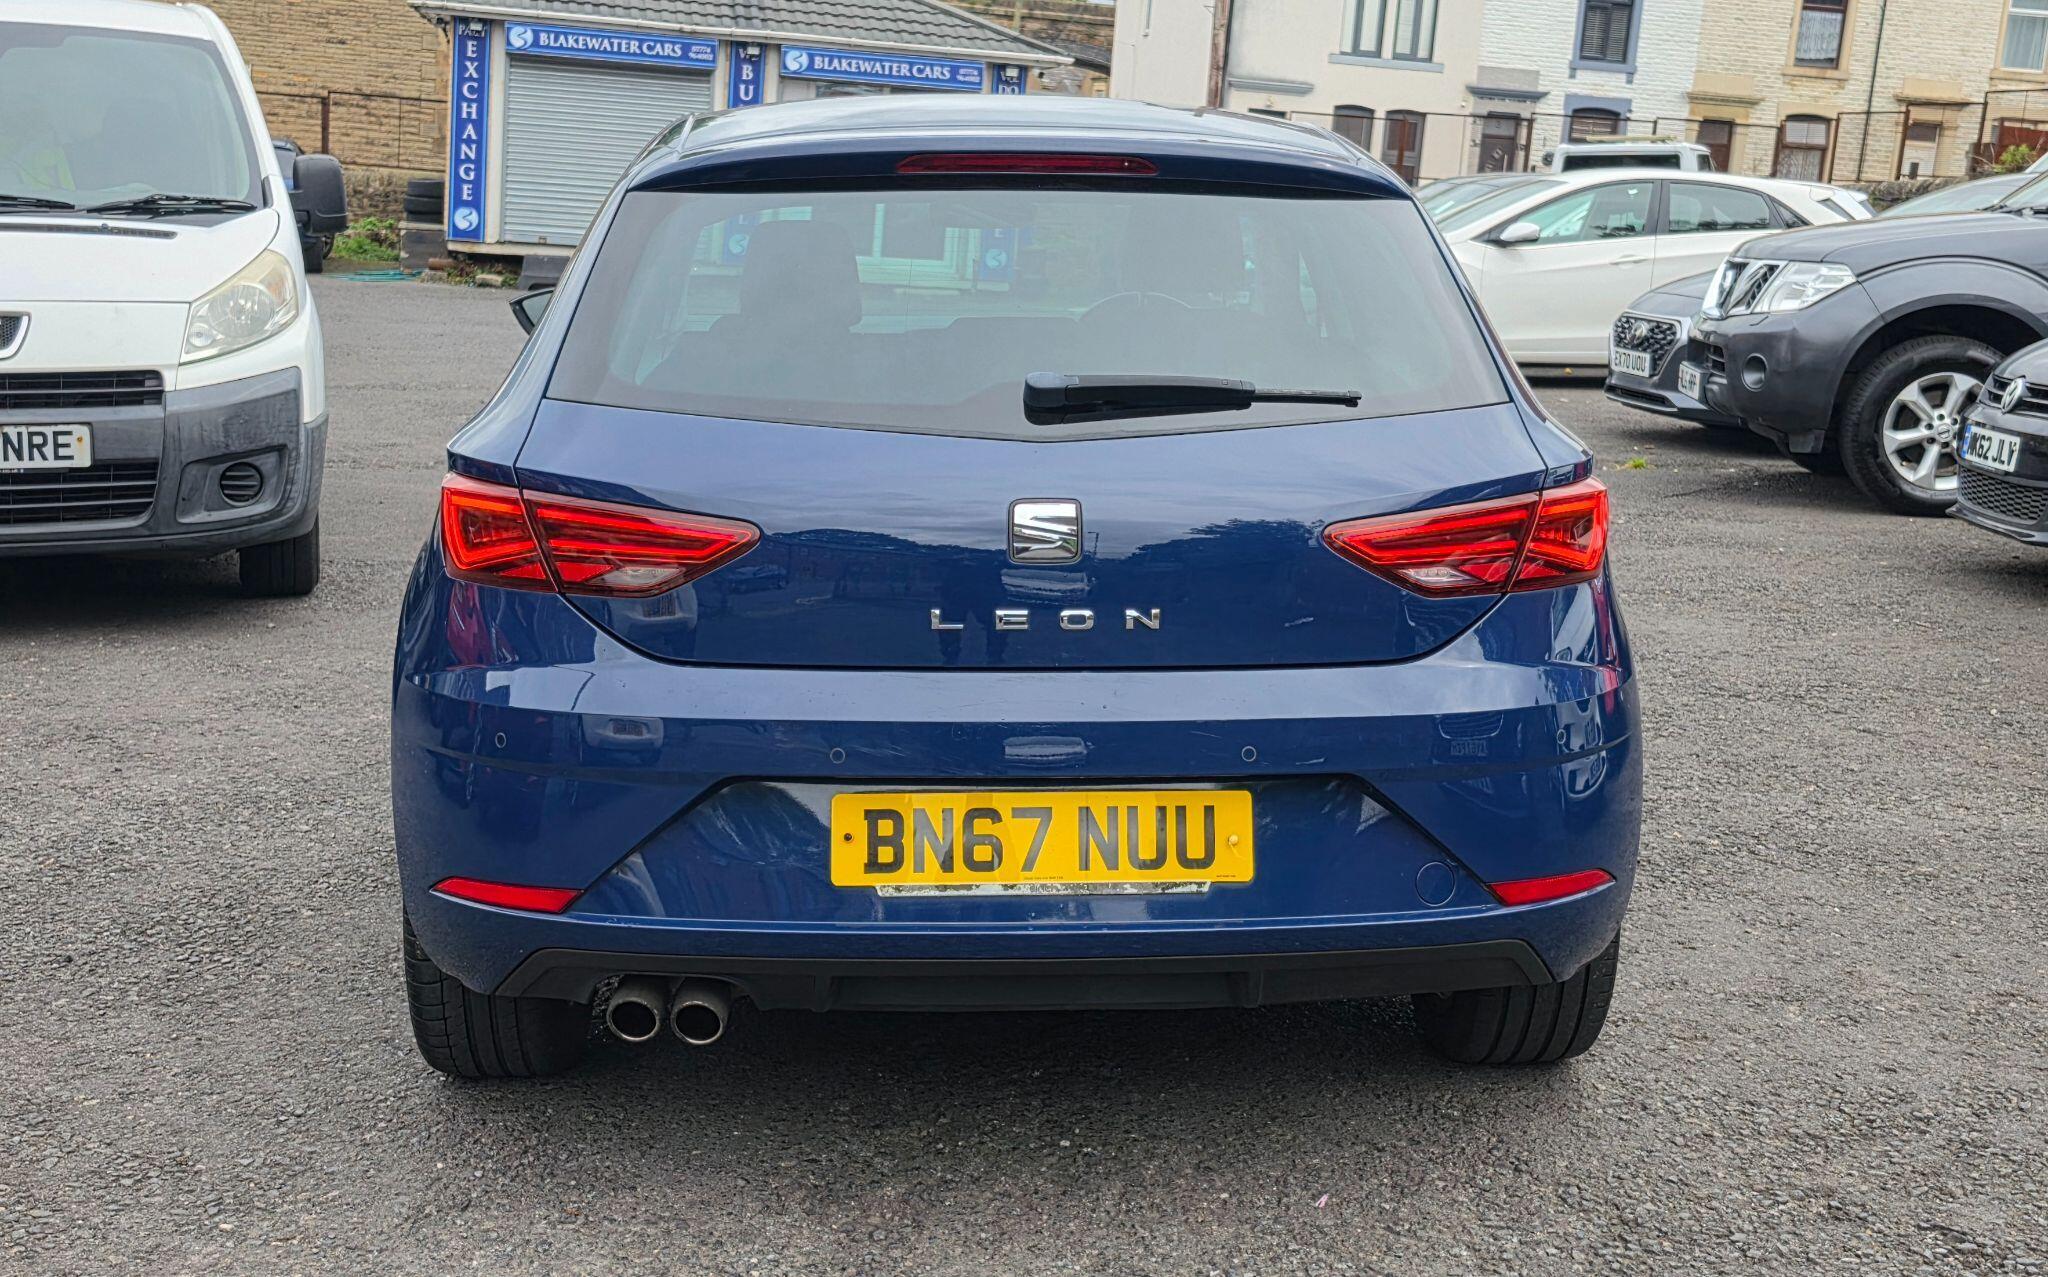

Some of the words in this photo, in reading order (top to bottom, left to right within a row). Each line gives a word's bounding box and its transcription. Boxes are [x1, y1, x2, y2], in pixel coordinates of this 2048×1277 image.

[539, 32, 641, 54] BLAKEWATER
[642, 41, 682, 57] CARS
[813, 56, 913, 76] BLAKEWATER
[912, 65, 951, 80] CARS
[739, 64, 754, 106] BU
[458, 40, 479, 200] EXCHANGE
[2, 431, 74, 462] NRE
[930, 608, 1160, 630] LEON
[863, 806, 1053, 875] BN67
[1078, 804, 1215, 873] NUU
